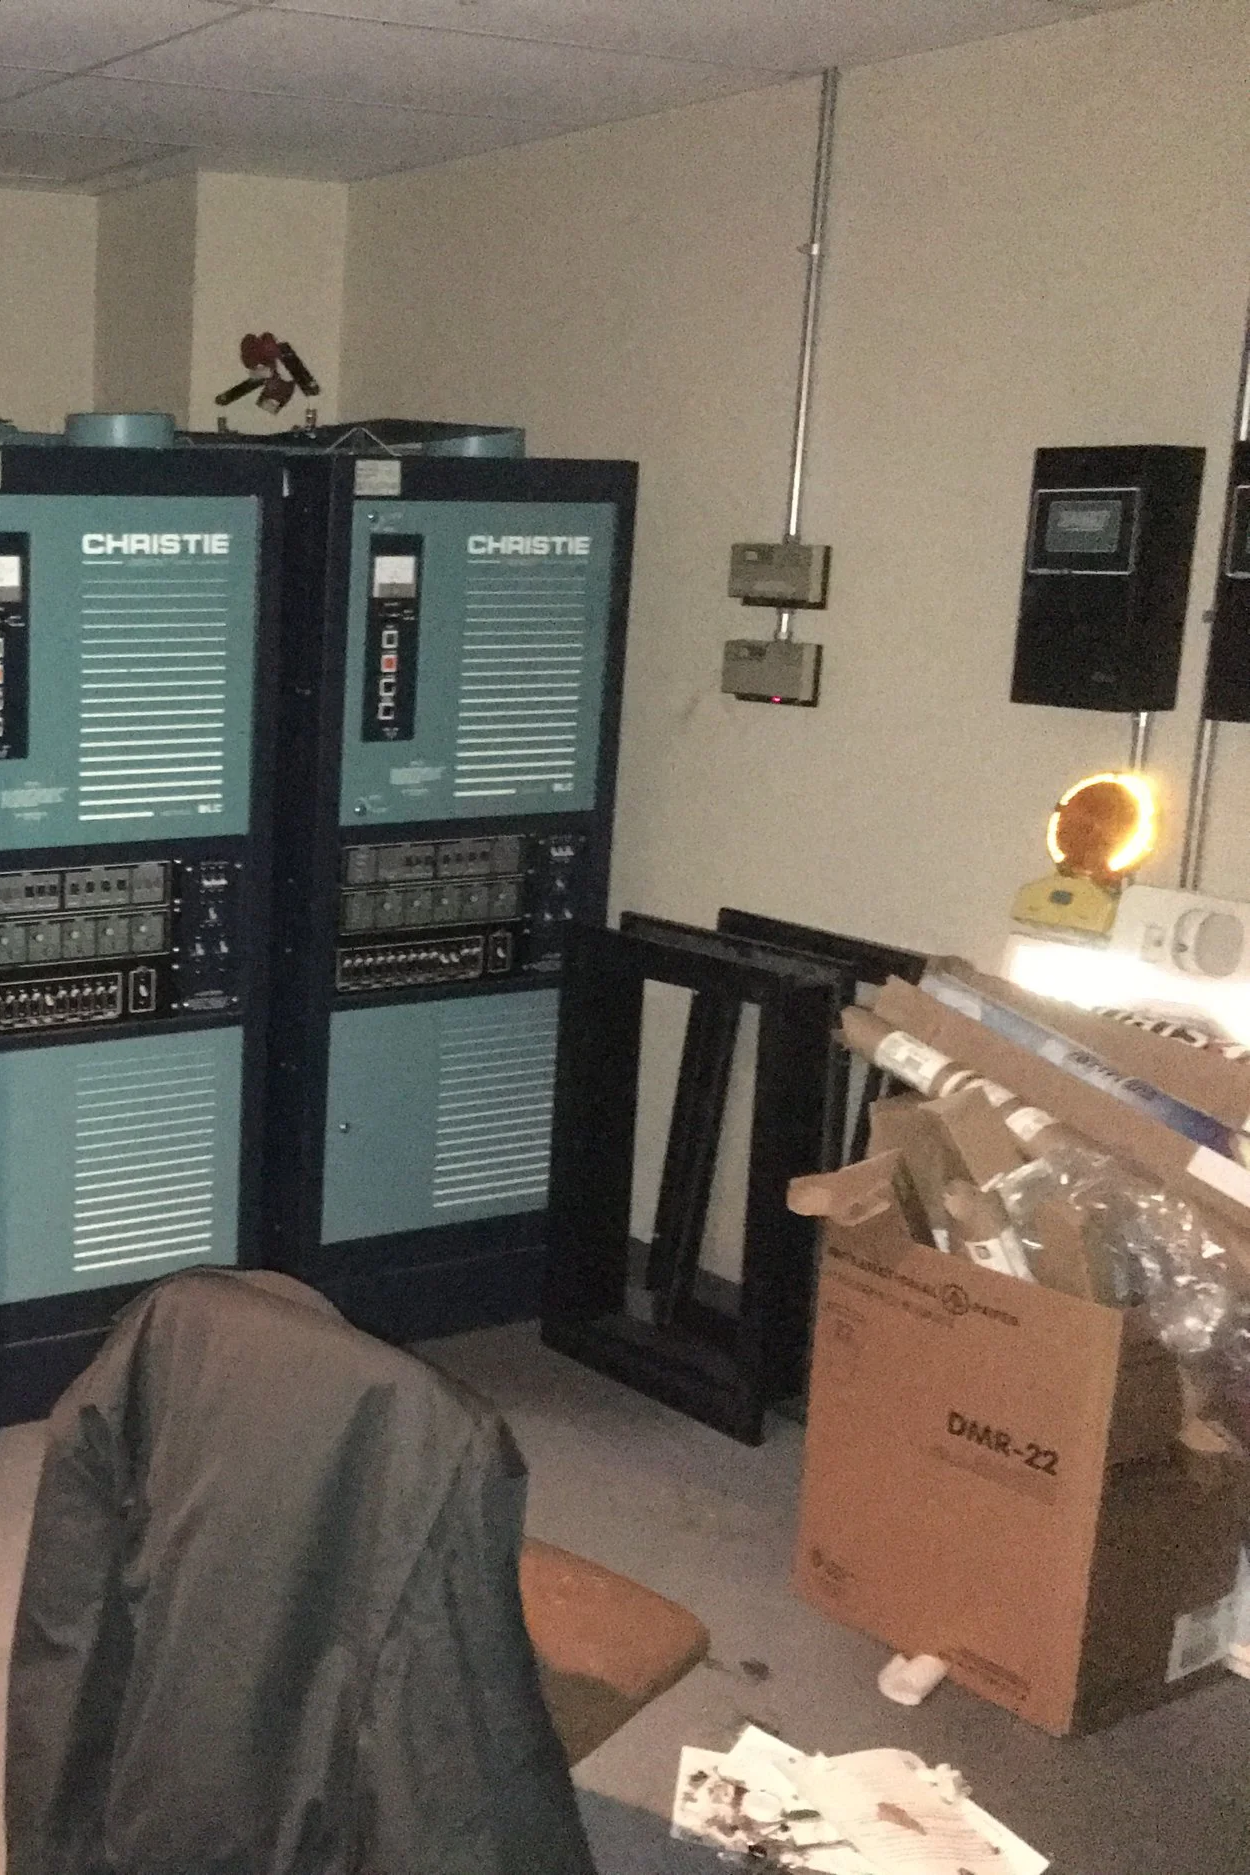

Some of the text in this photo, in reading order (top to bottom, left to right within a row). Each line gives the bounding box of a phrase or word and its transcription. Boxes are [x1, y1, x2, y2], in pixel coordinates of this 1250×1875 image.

[82, 533, 230, 555] CHRISTIE
[467, 535, 591, 555] CHRISTIE
[945, 1410, 1059, 1477] DMR-22
